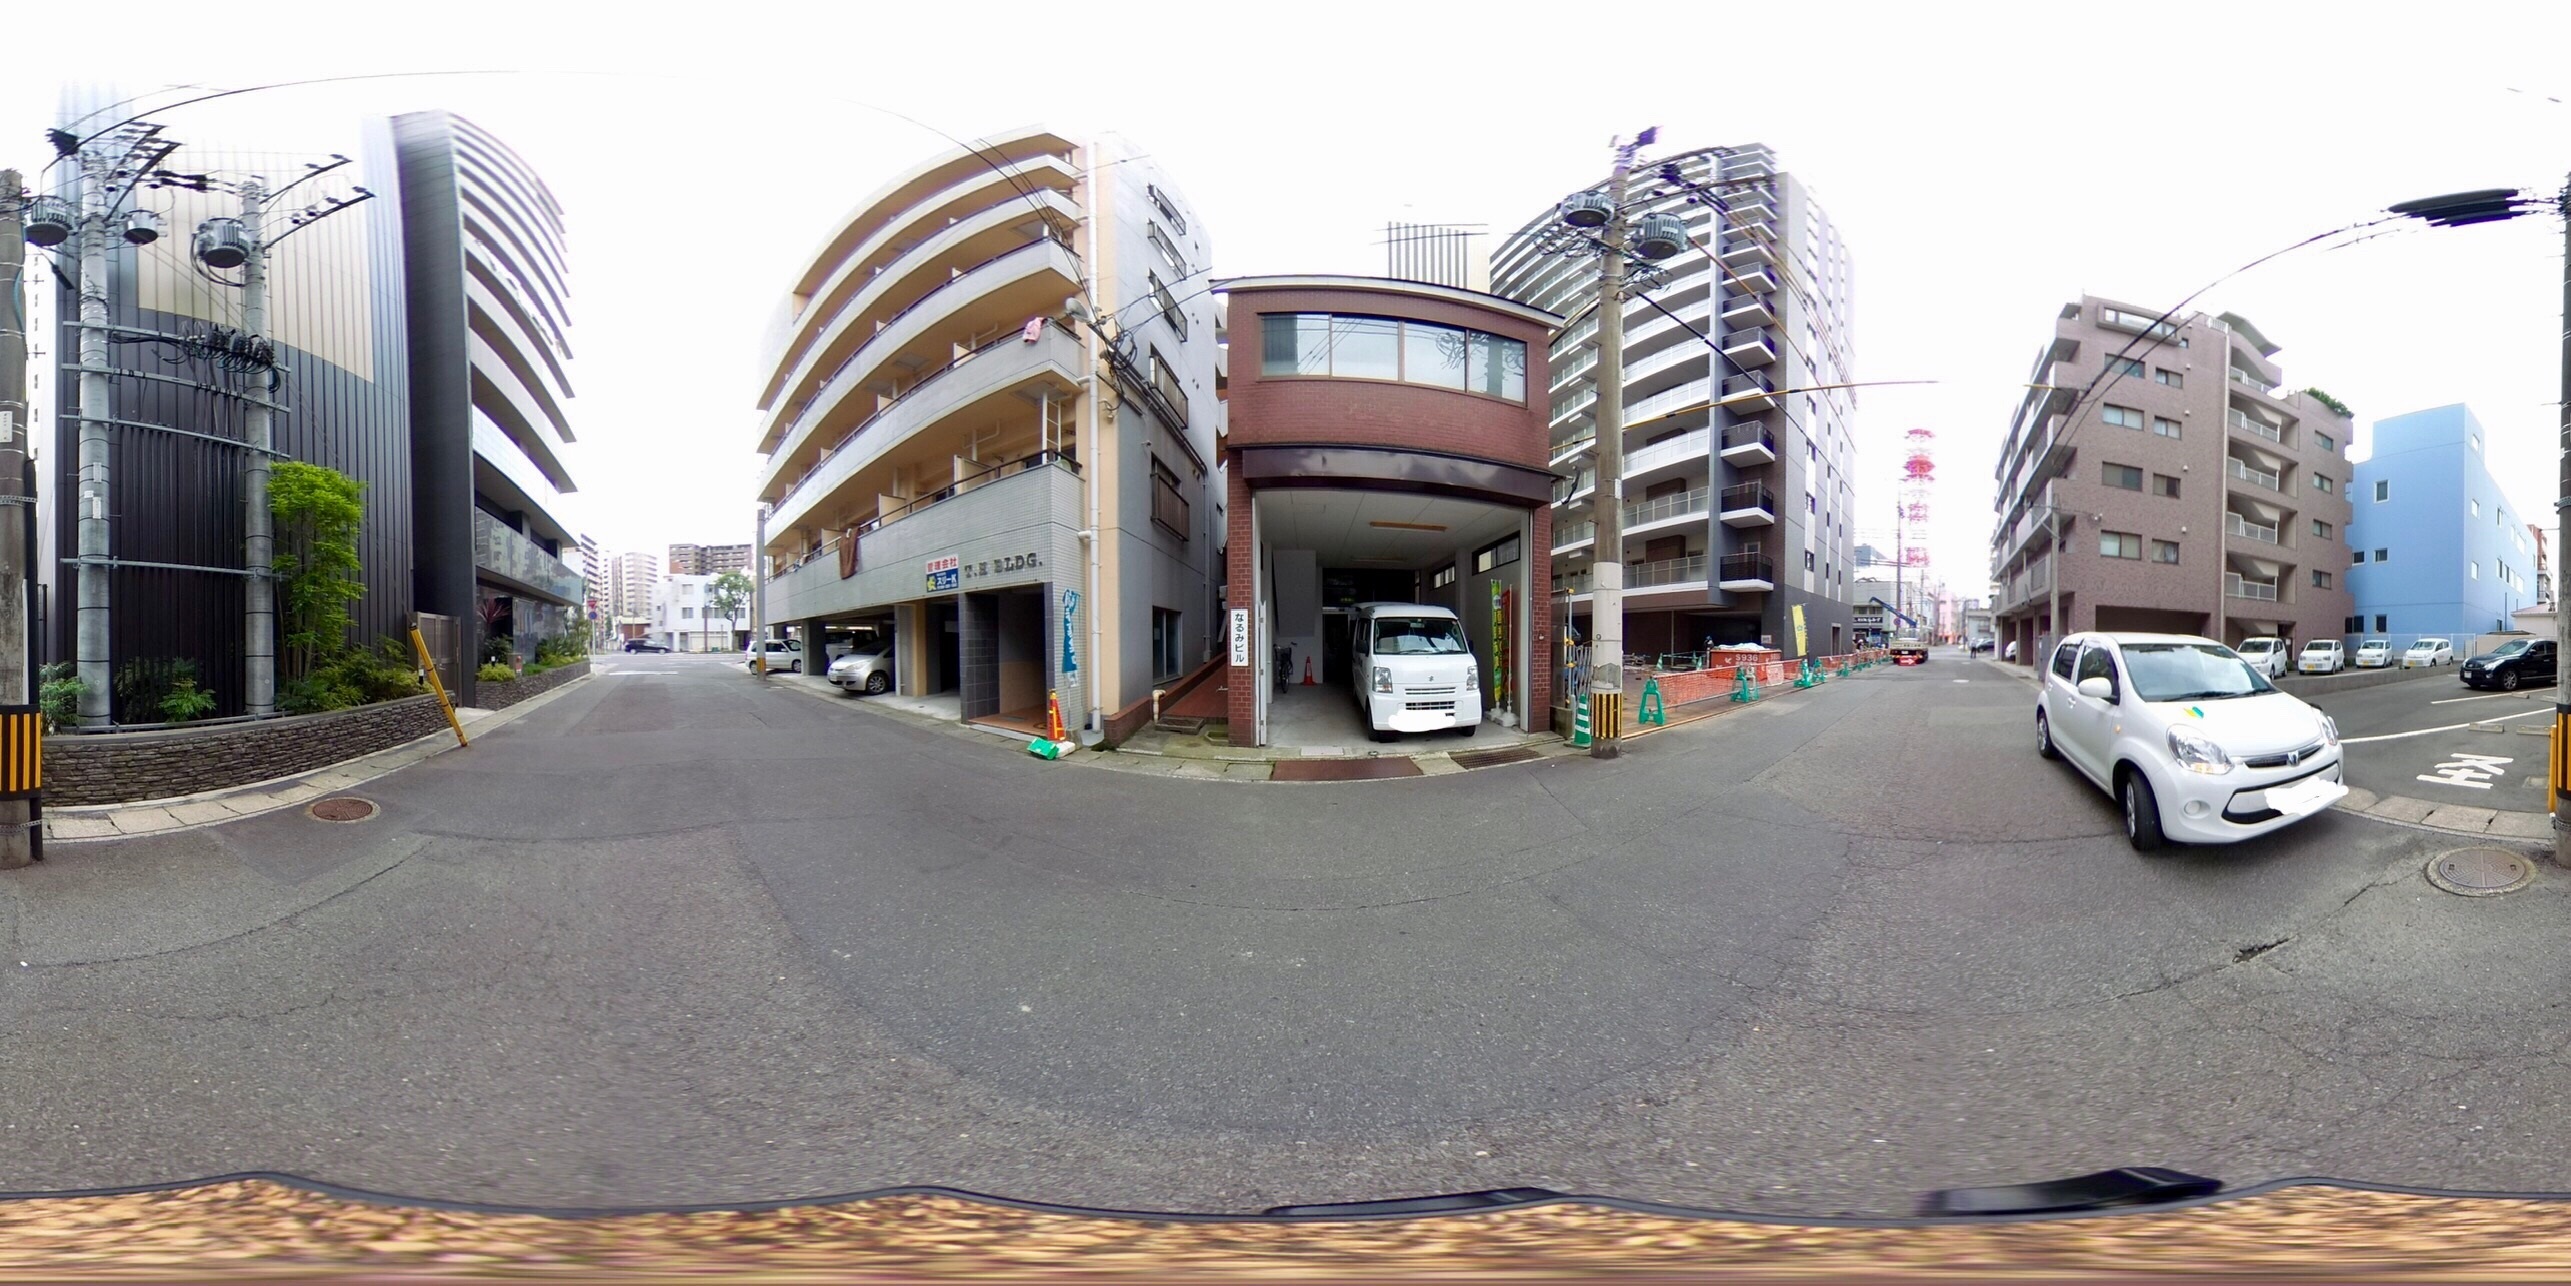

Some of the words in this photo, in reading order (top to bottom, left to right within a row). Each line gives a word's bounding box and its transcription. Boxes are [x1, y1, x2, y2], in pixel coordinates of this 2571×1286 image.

[927, 557, 957, 572] 管理会社
[995, 553, 1043, 573] BLDG.
[1235, 613, 1244, 663] なるみビル
[1735, 653, 1758, 662] S936
